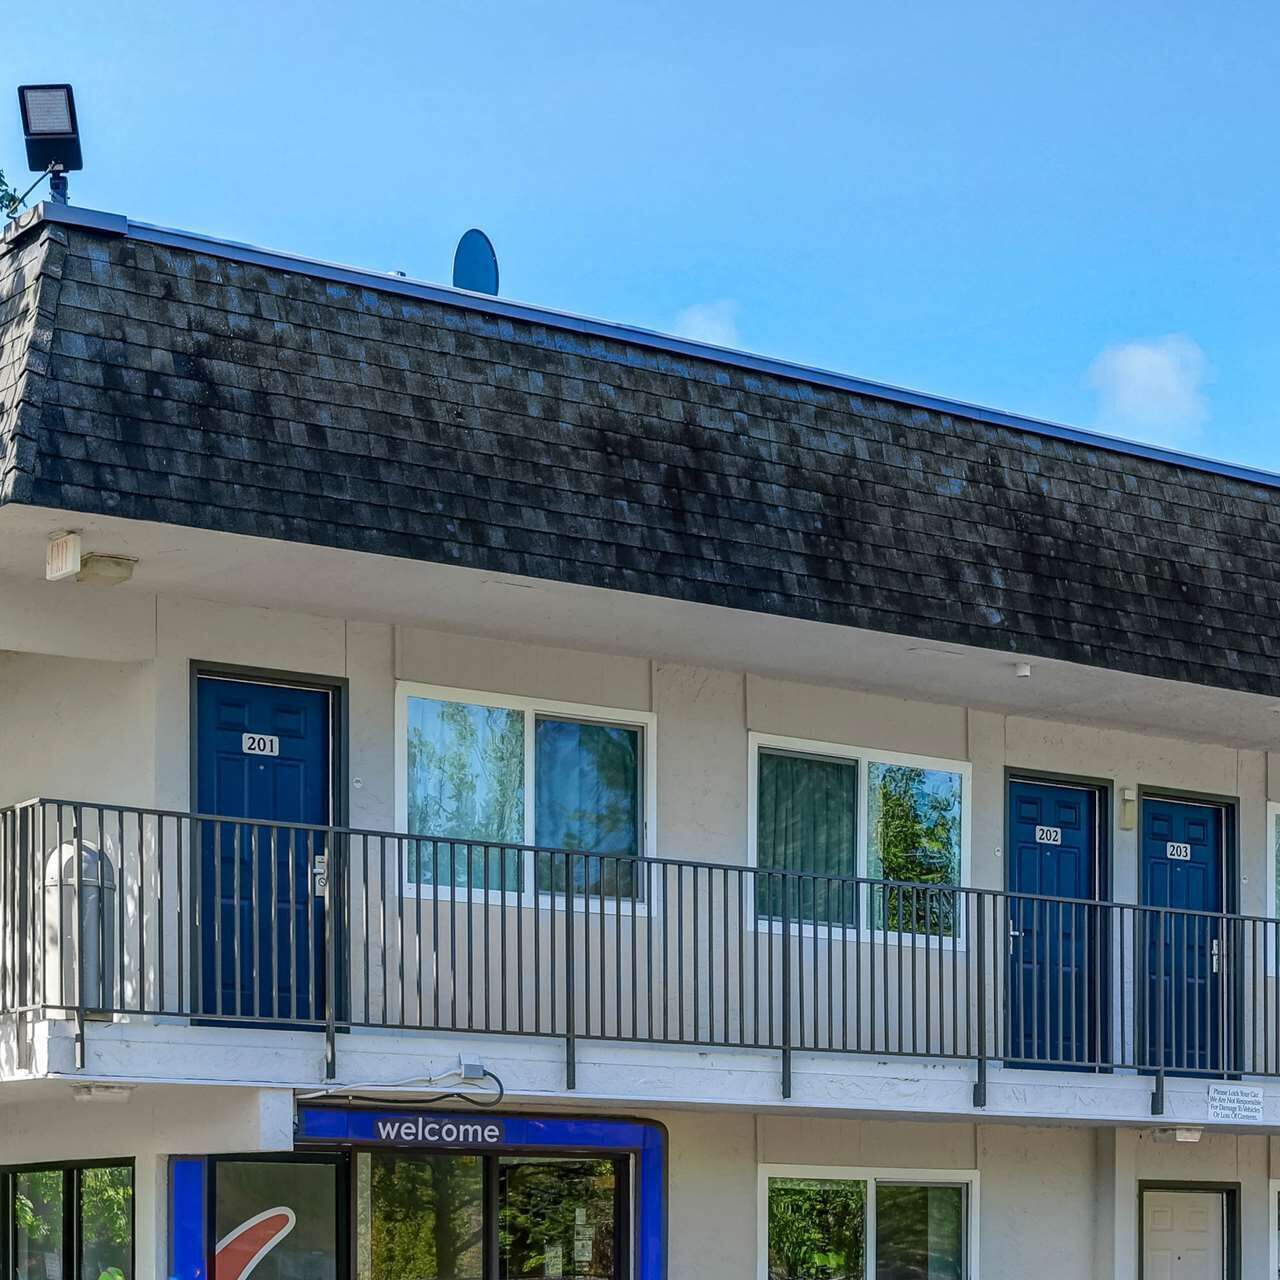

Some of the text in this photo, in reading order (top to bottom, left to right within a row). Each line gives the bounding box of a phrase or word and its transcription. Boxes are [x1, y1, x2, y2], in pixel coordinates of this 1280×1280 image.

[247, 736, 274, 753] 201
[1039, 828, 1059, 842] 202
[1169, 844, 1188, 858] 203
[378, 1117, 500, 1142] welcome
